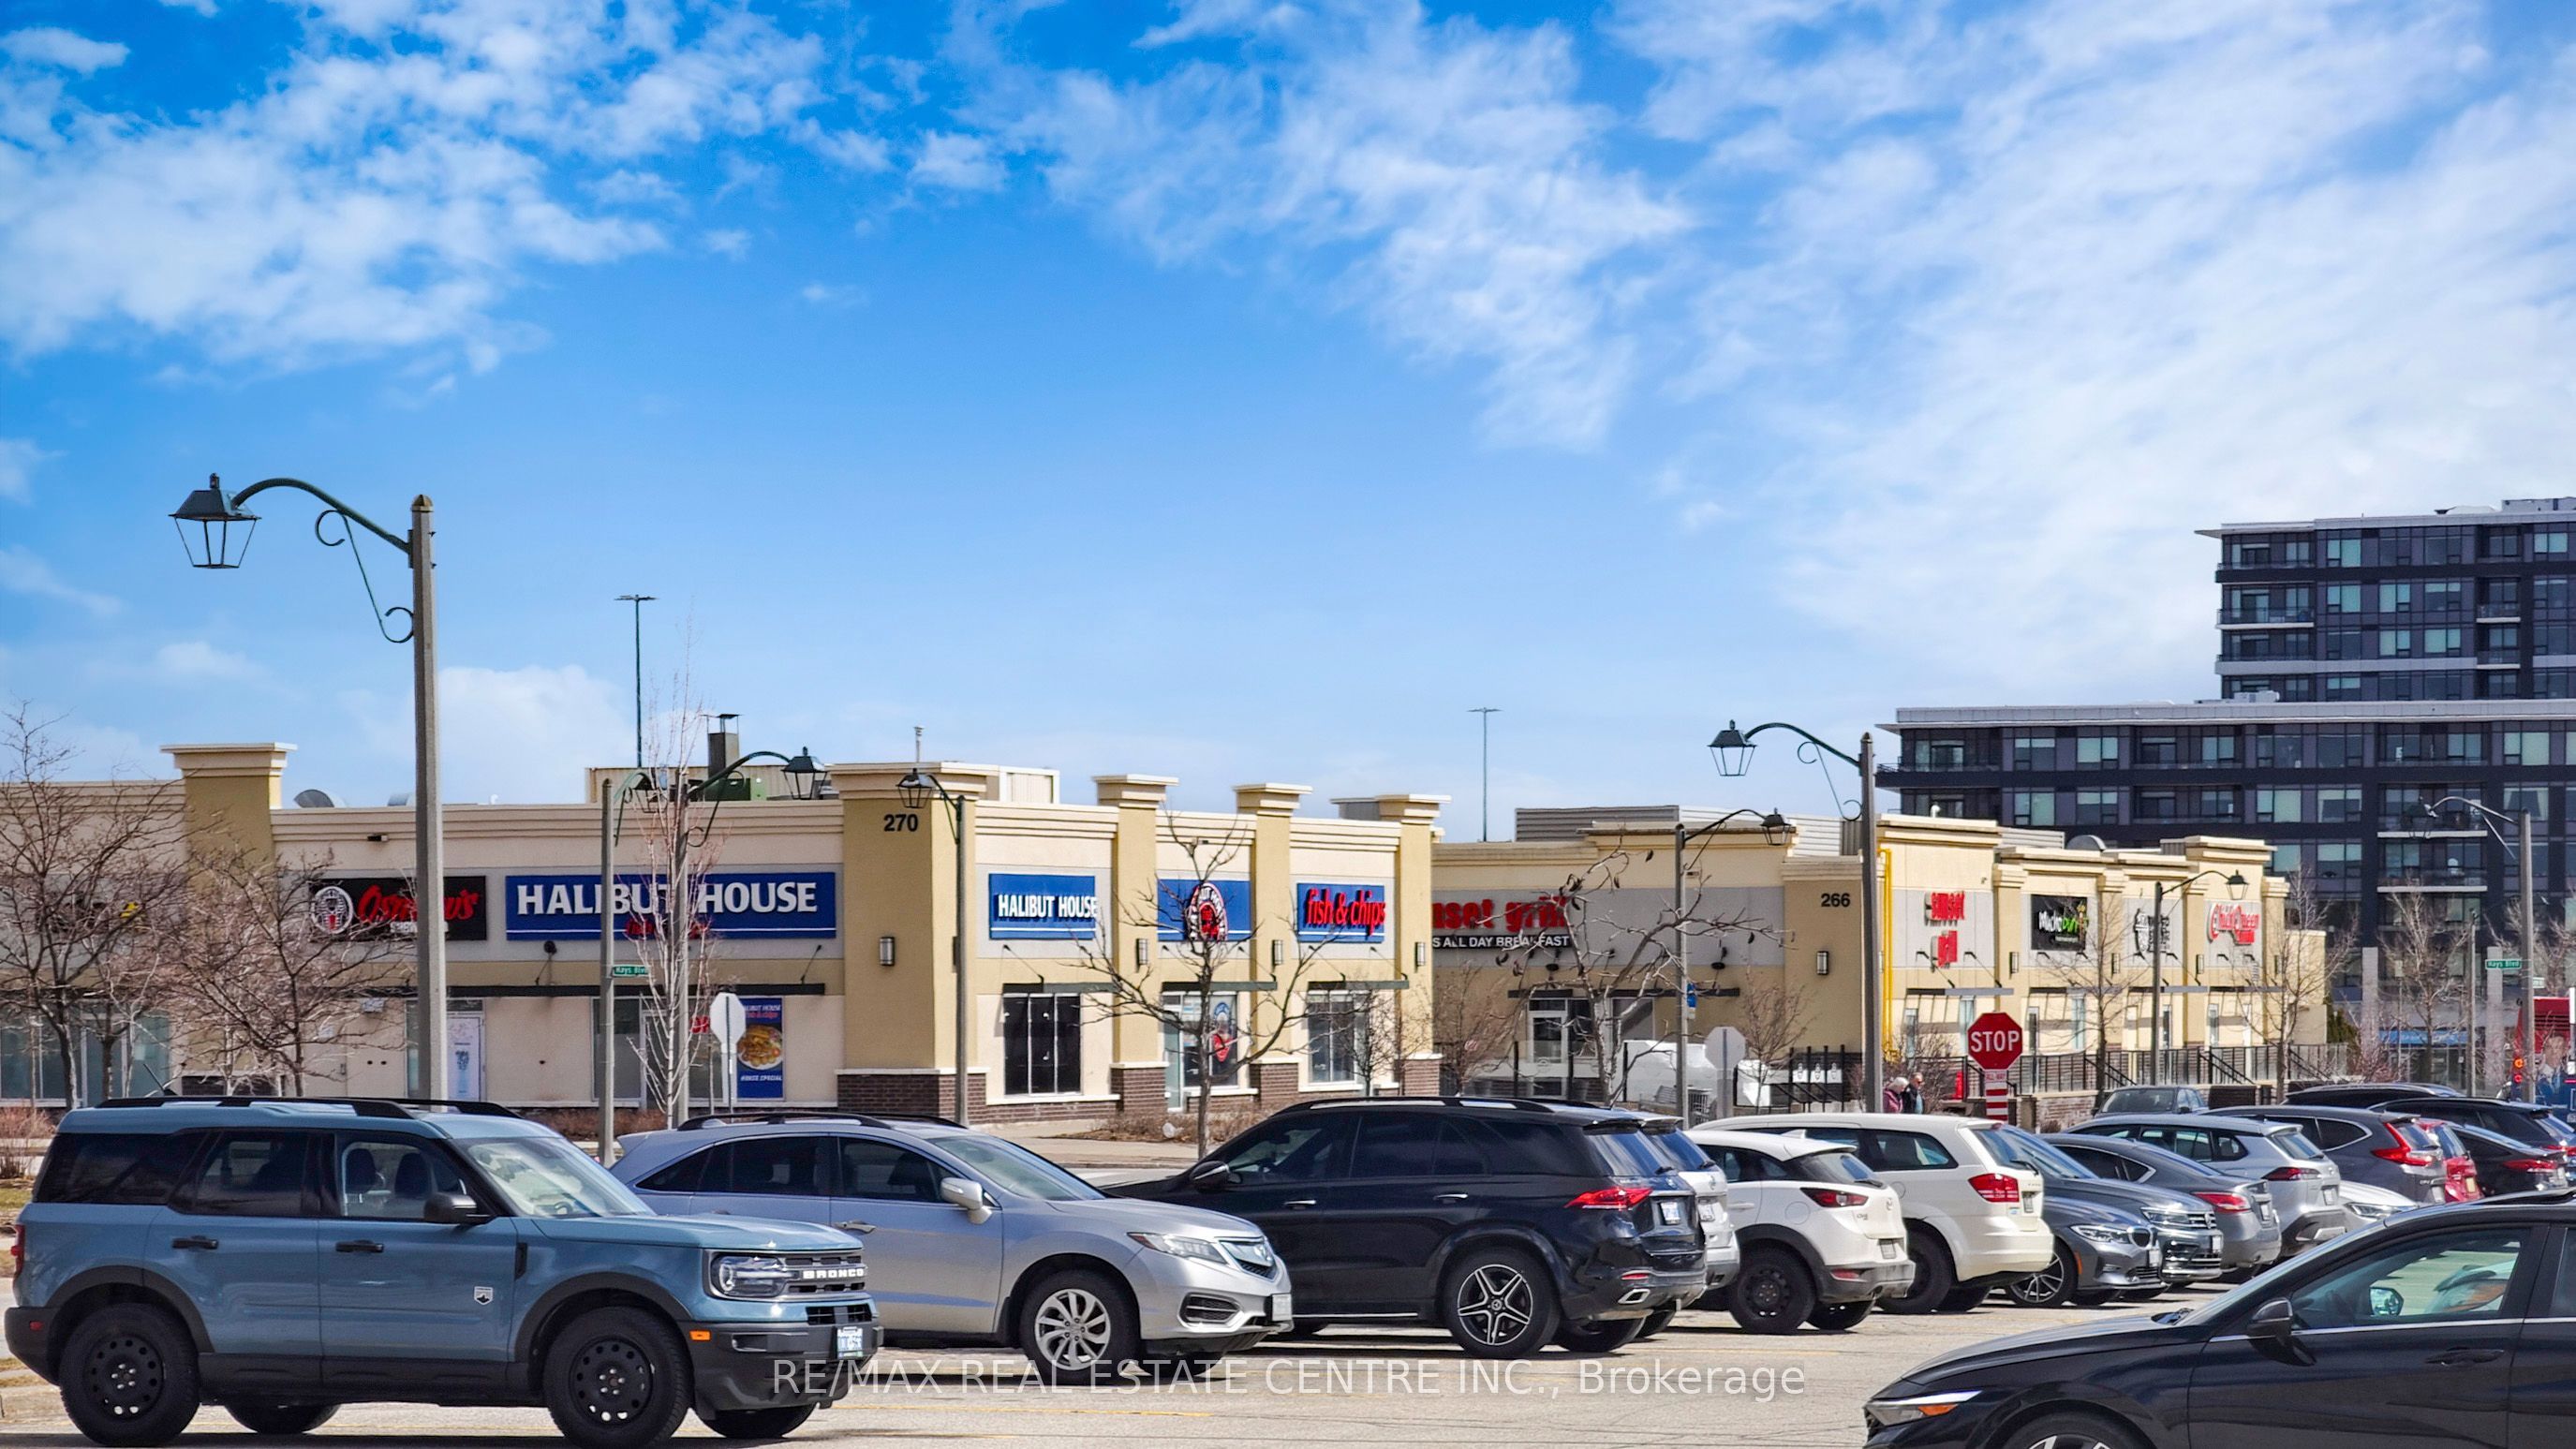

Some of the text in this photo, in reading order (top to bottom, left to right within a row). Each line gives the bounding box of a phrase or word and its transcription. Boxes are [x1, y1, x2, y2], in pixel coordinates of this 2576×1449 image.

[883, 814, 919, 832] 270
[698, 881, 818, 913] HOUSE
[998, 895, 1098, 918] HALIBUT HOUSE
[1821, 893, 1851, 908] 266
[1307, 888, 1385, 937] fish & chips
[1443, 938, 1466, 948] ALL
[1469, 937, 1492, 947] DAY
[1971, 1030, 2020, 1053] STOP
[803, 1268, 864, 1279] BRONCO
